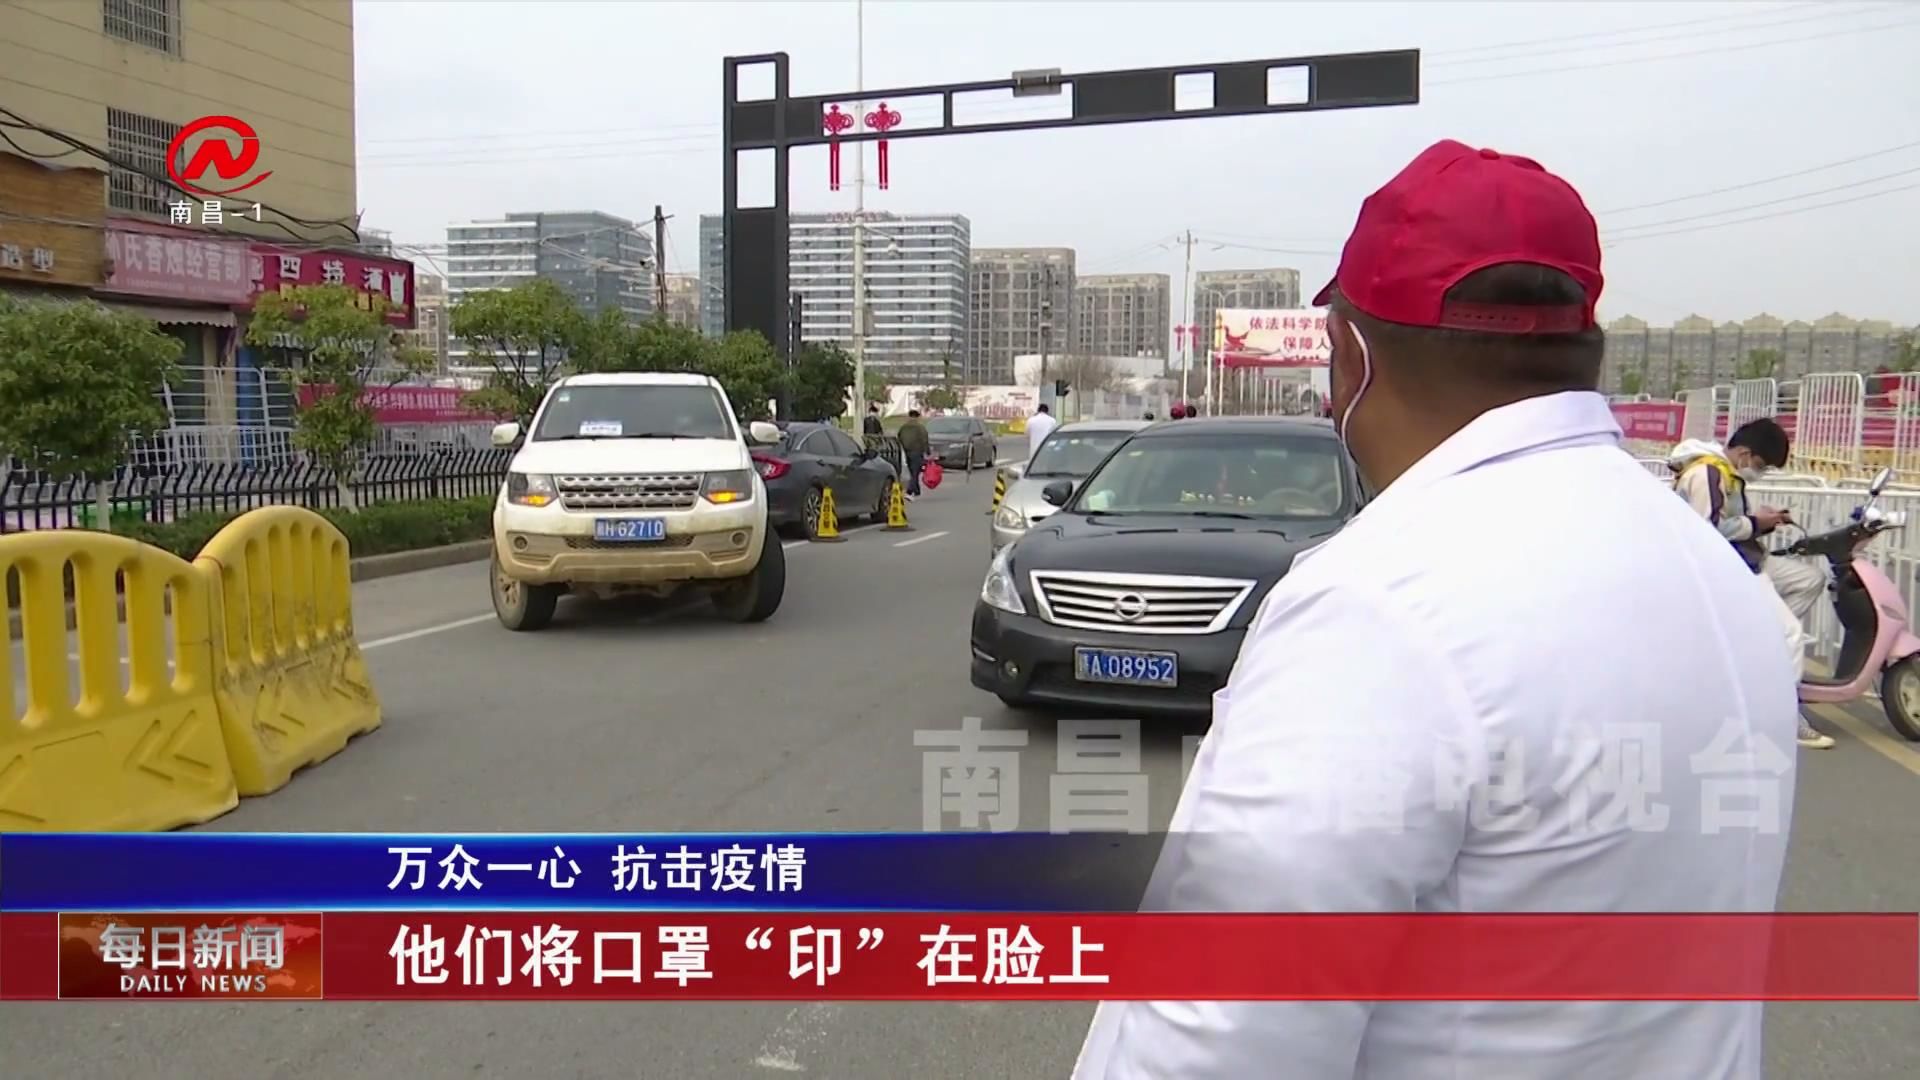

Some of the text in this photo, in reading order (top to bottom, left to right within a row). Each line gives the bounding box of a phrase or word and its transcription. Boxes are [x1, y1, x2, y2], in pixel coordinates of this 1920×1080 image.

[279, 255, 383, 291] 四特酒
[1283, 336, 1328, 351] 保障人
